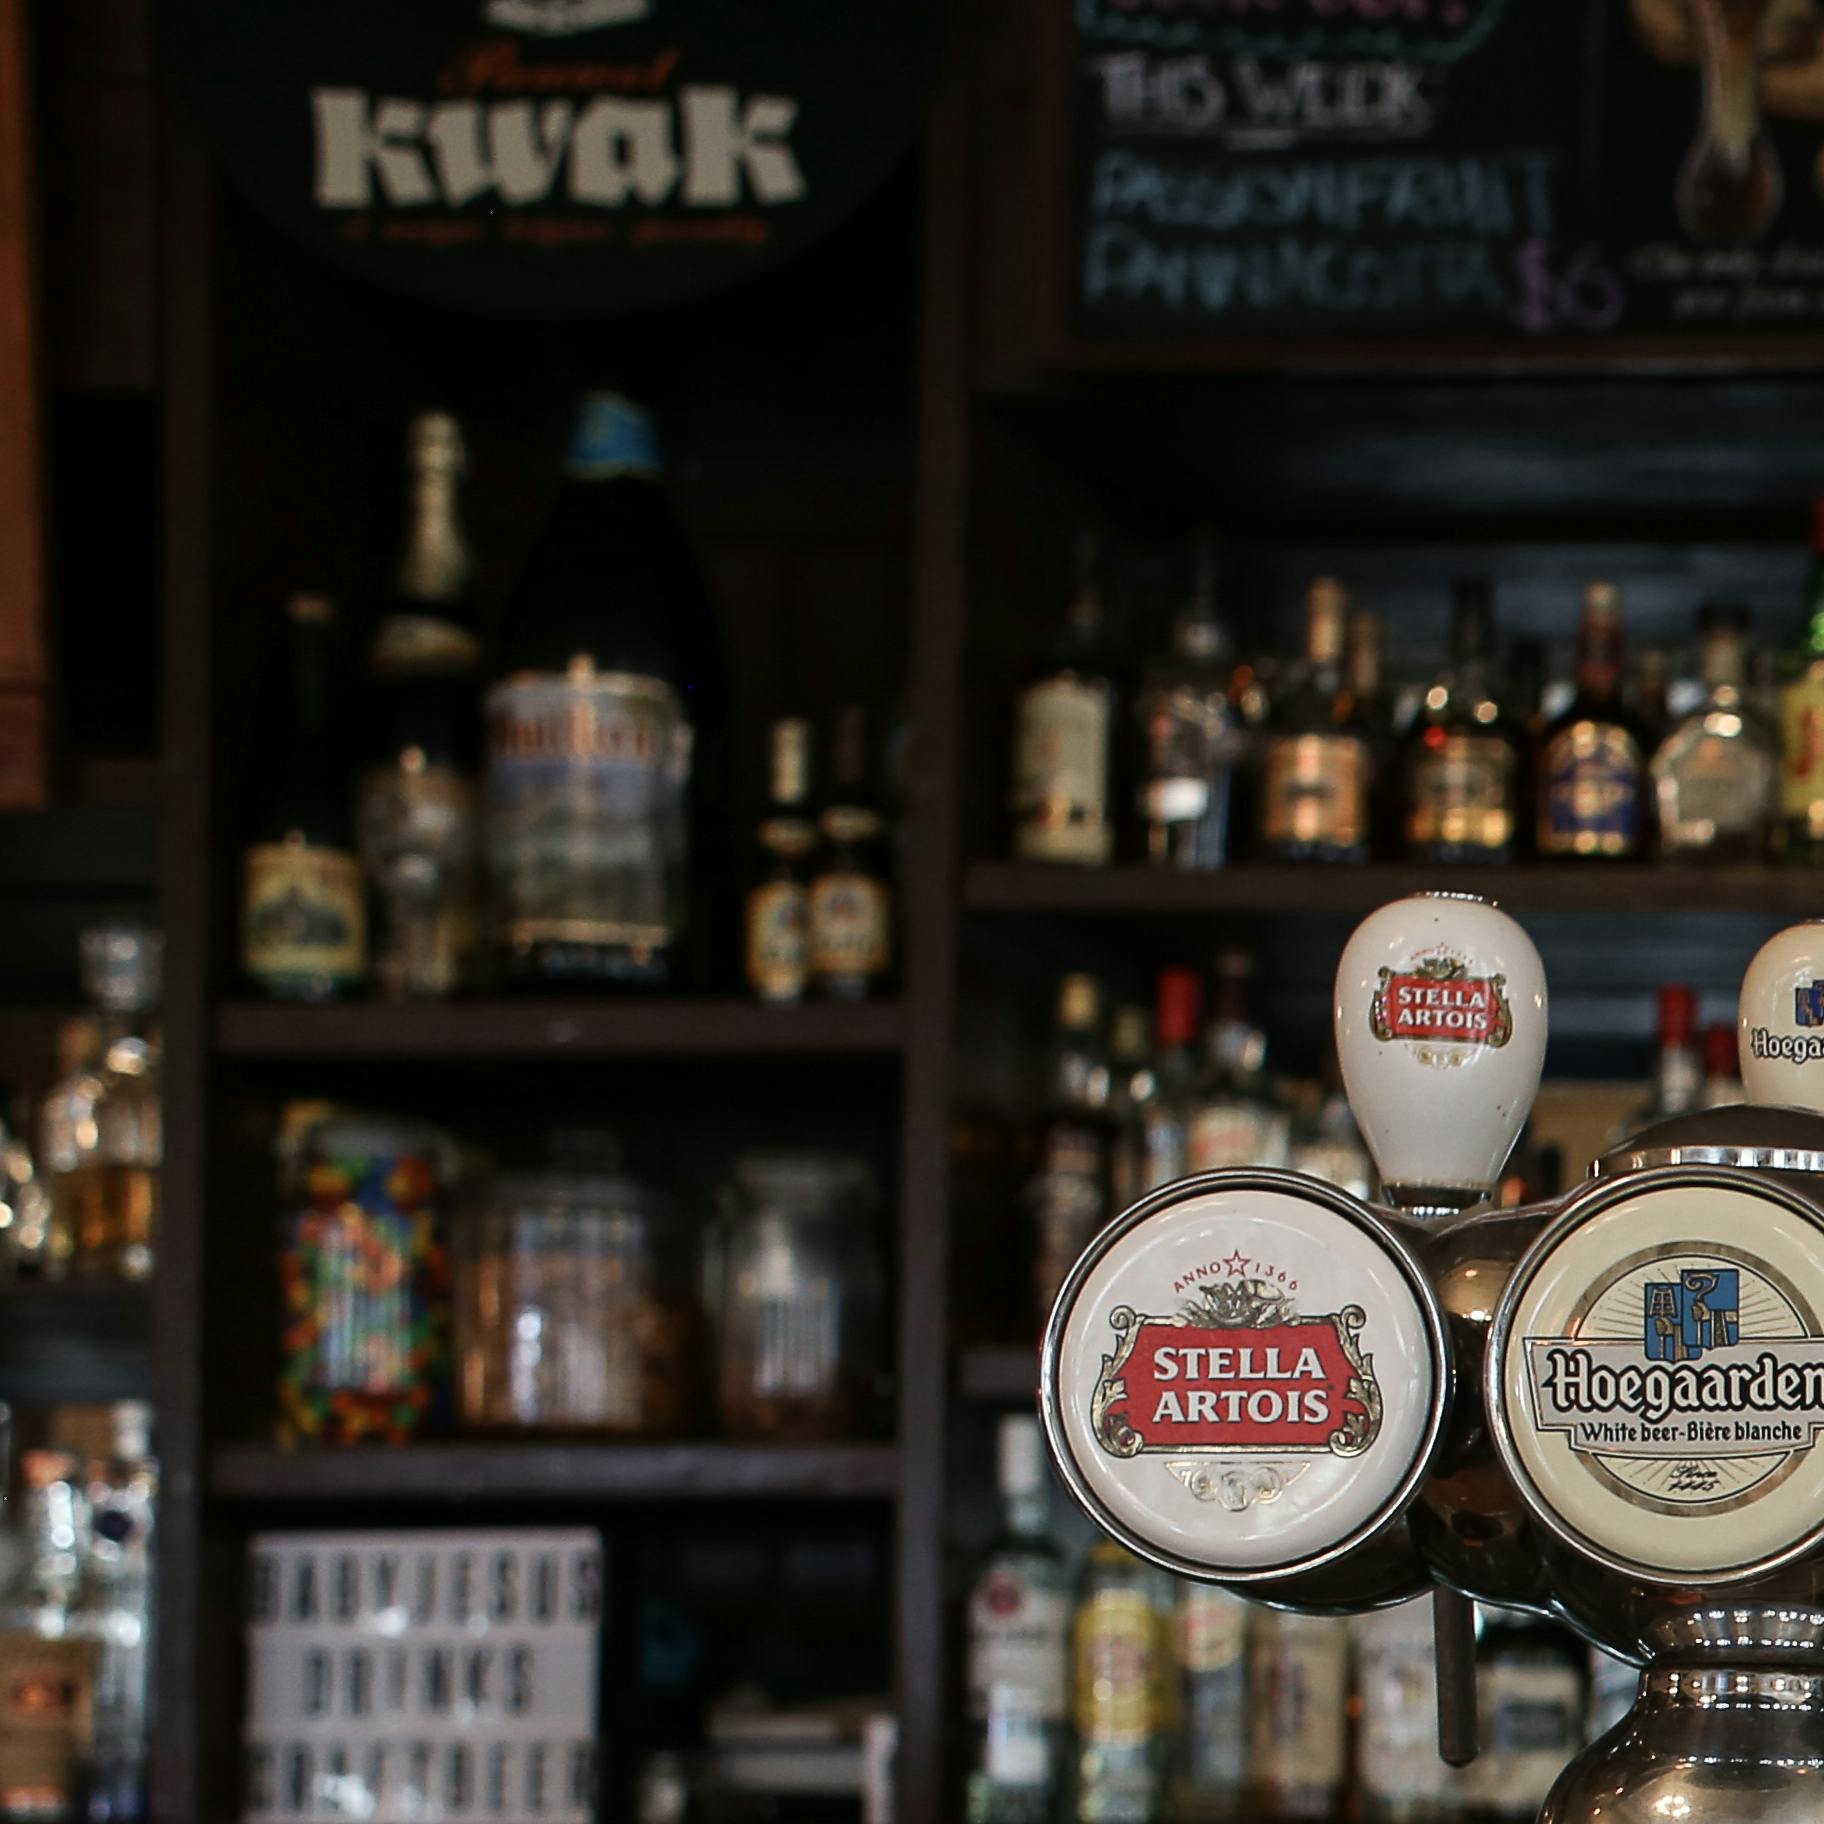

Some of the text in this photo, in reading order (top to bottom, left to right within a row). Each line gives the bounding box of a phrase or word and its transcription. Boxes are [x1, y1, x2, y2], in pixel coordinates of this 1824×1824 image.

[1398, 986, 1486, 1009] STELLA
[1397, 1009, 1489, 1031] ARTOIS
[1173, 1262, 1300, 1294] ANNO 1366
[1152, 1346, 1327, 1382] STELLA
[1151, 1389, 1330, 1425] ARTOIS
[1578, 1422, 1638, 1443] White
[1735, 1421, 1802, 1442] blanche
